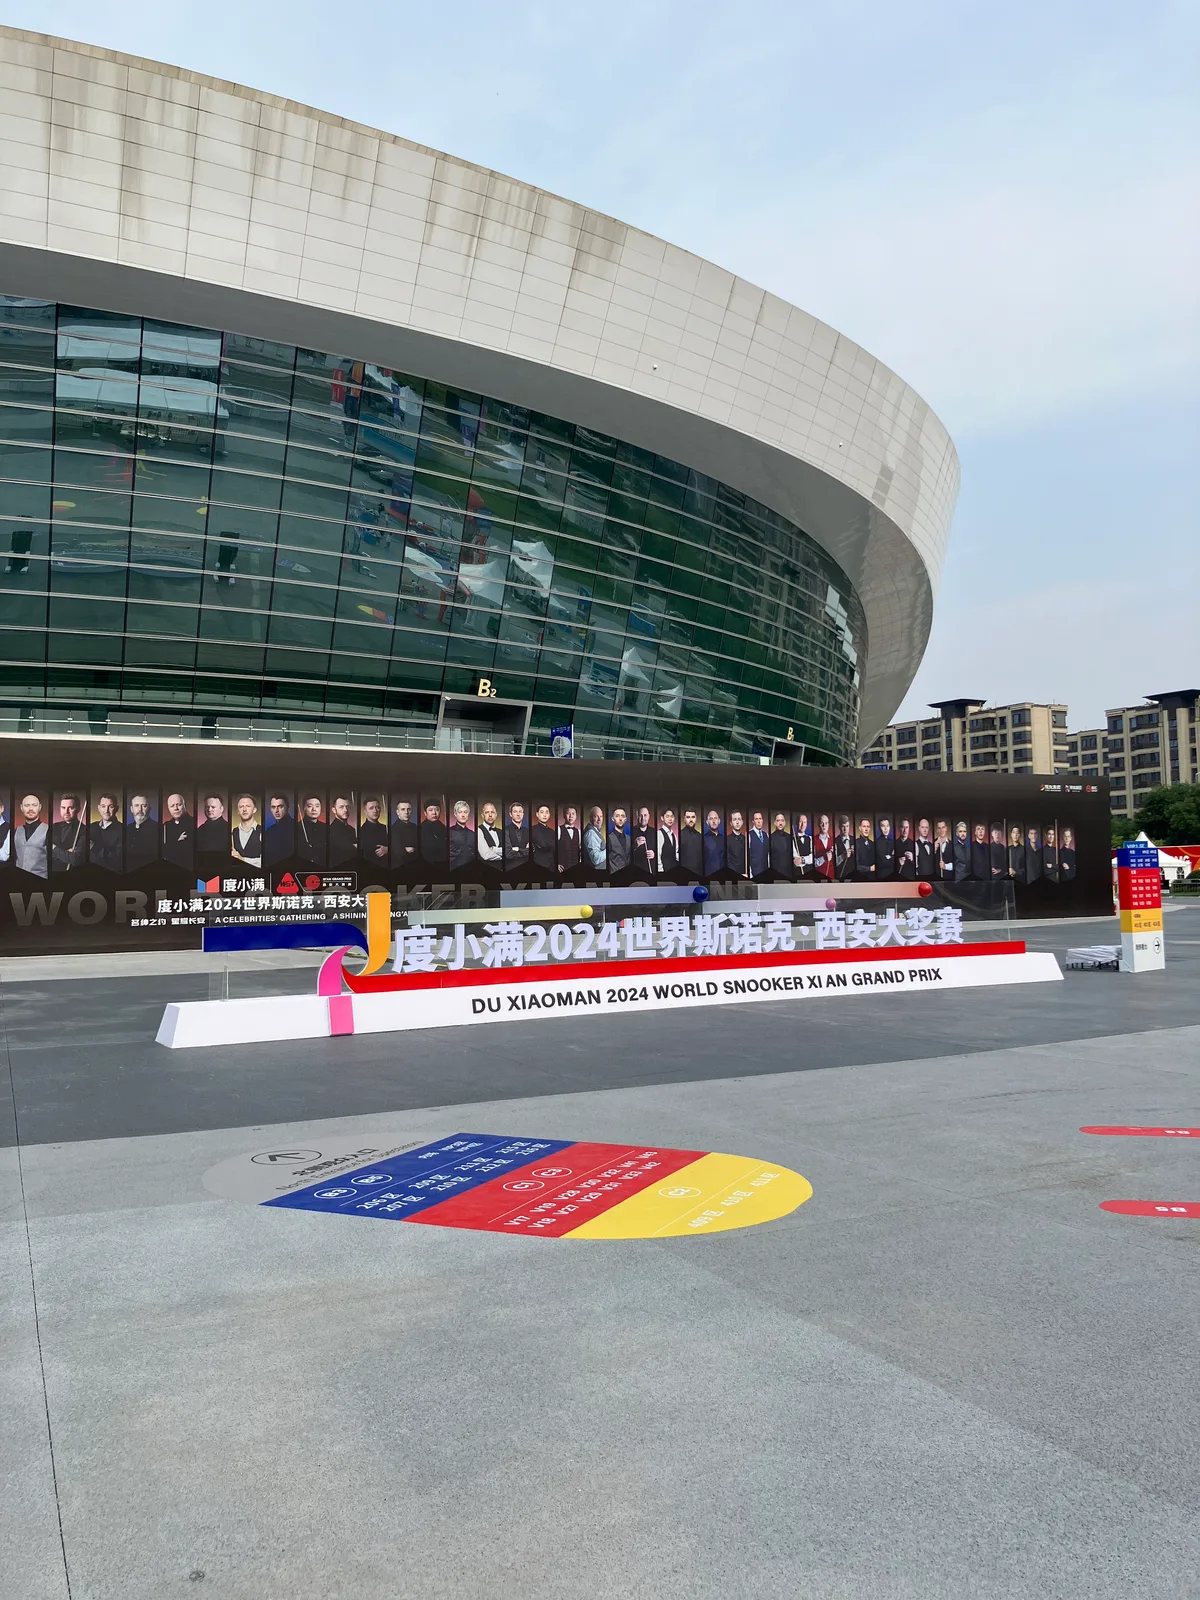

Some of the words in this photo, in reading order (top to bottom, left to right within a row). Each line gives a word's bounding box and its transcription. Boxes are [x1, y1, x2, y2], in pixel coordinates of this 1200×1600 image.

[223, 878, 265, 892] 度小满
[223, 914, 278, 924] CELEBRITIES'
[280, 913, 326, 921] GATHERING
[391, 906, 964, 974] 度小满2024世界斯诺克·西安大奖赛
[471, 996, 501, 1014] DU
[507, 989, 602, 1012] XIAOMAN
[606, 986, 649, 1004] 2024
[653, 980, 719, 999] WORLD
[723, 975, 804, 995] SNOOKER
[851, 969, 905, 987] GRAND
[908, 968, 943, 982] PRIX
[553, 1205, 579, 1214] V27
[504, 1216, 530, 1224] V17
